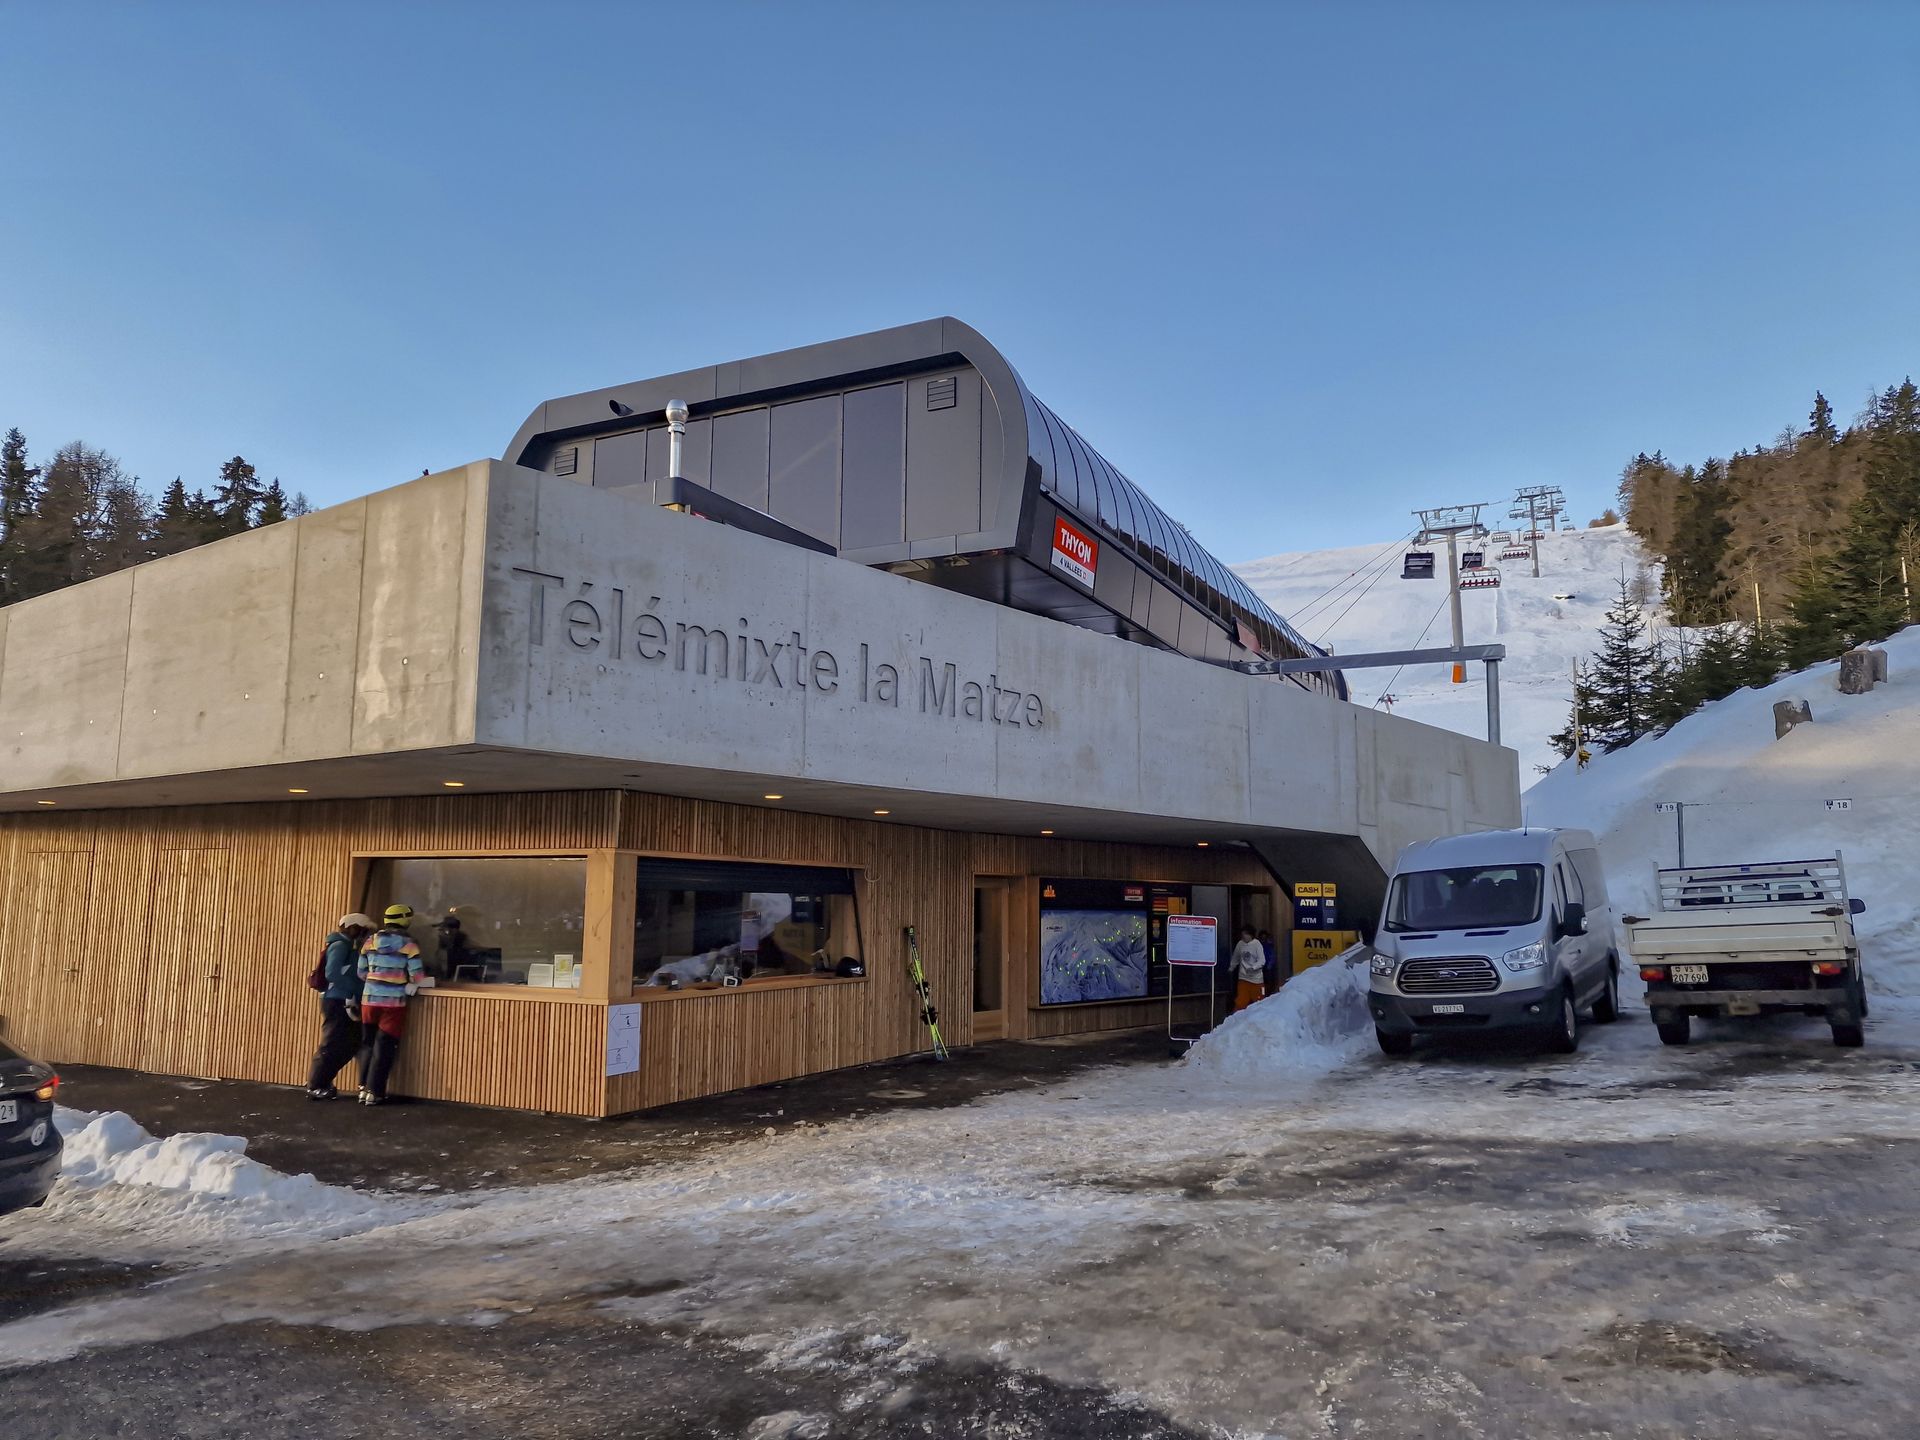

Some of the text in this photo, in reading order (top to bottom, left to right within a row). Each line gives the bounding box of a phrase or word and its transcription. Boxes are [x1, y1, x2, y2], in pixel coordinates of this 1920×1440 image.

[1061, 527, 1092, 564] THYON
[512, 567, 1044, 730] Télémixte la Matze
[1665, 804, 1674, 812] 19
[1837, 801, 1848, 809] 18
[1297, 886, 1319, 894] CASH
[1300, 899, 1318, 907] ATM
[1303, 938, 1332, 949] ATM
[1307, 951, 1329, 960] Cash
